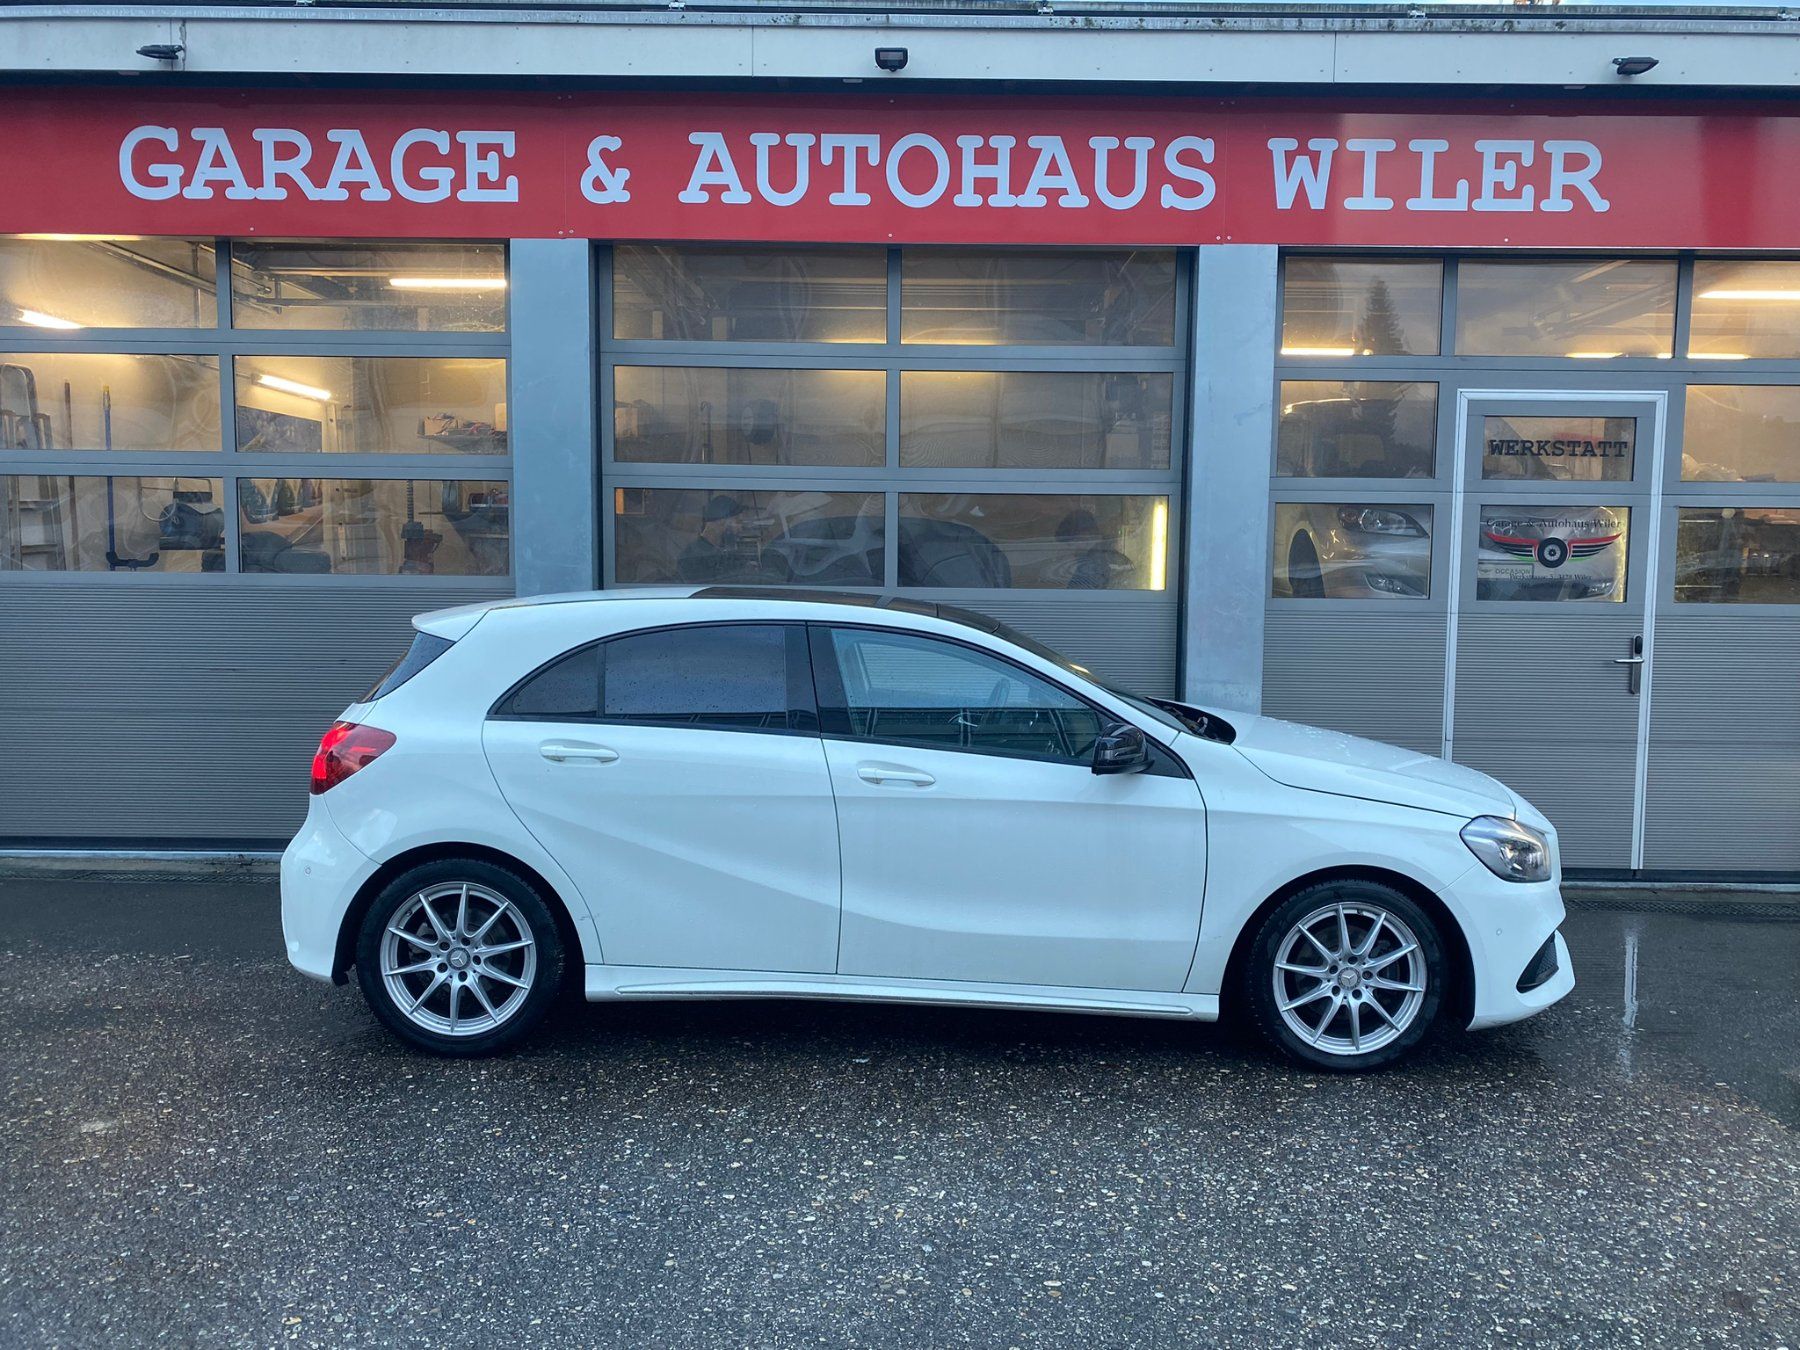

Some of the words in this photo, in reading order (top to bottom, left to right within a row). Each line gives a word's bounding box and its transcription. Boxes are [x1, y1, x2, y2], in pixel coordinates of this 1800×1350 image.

[119, 126, 520, 204] GARAGE
[580, 136, 631, 205] &
[678, 132, 1216, 211] AUTOHAUS
[1267, 137, 1611, 213] WILER
[1488, 440, 1629, 458] WERKSTATT
[1486, 518, 1523, 530] Garage
[1528, 518, 1538, 528] &
[1540, 518, 1588, 528] Autohaus
[1592, 517, 1622, 528] Wiler
